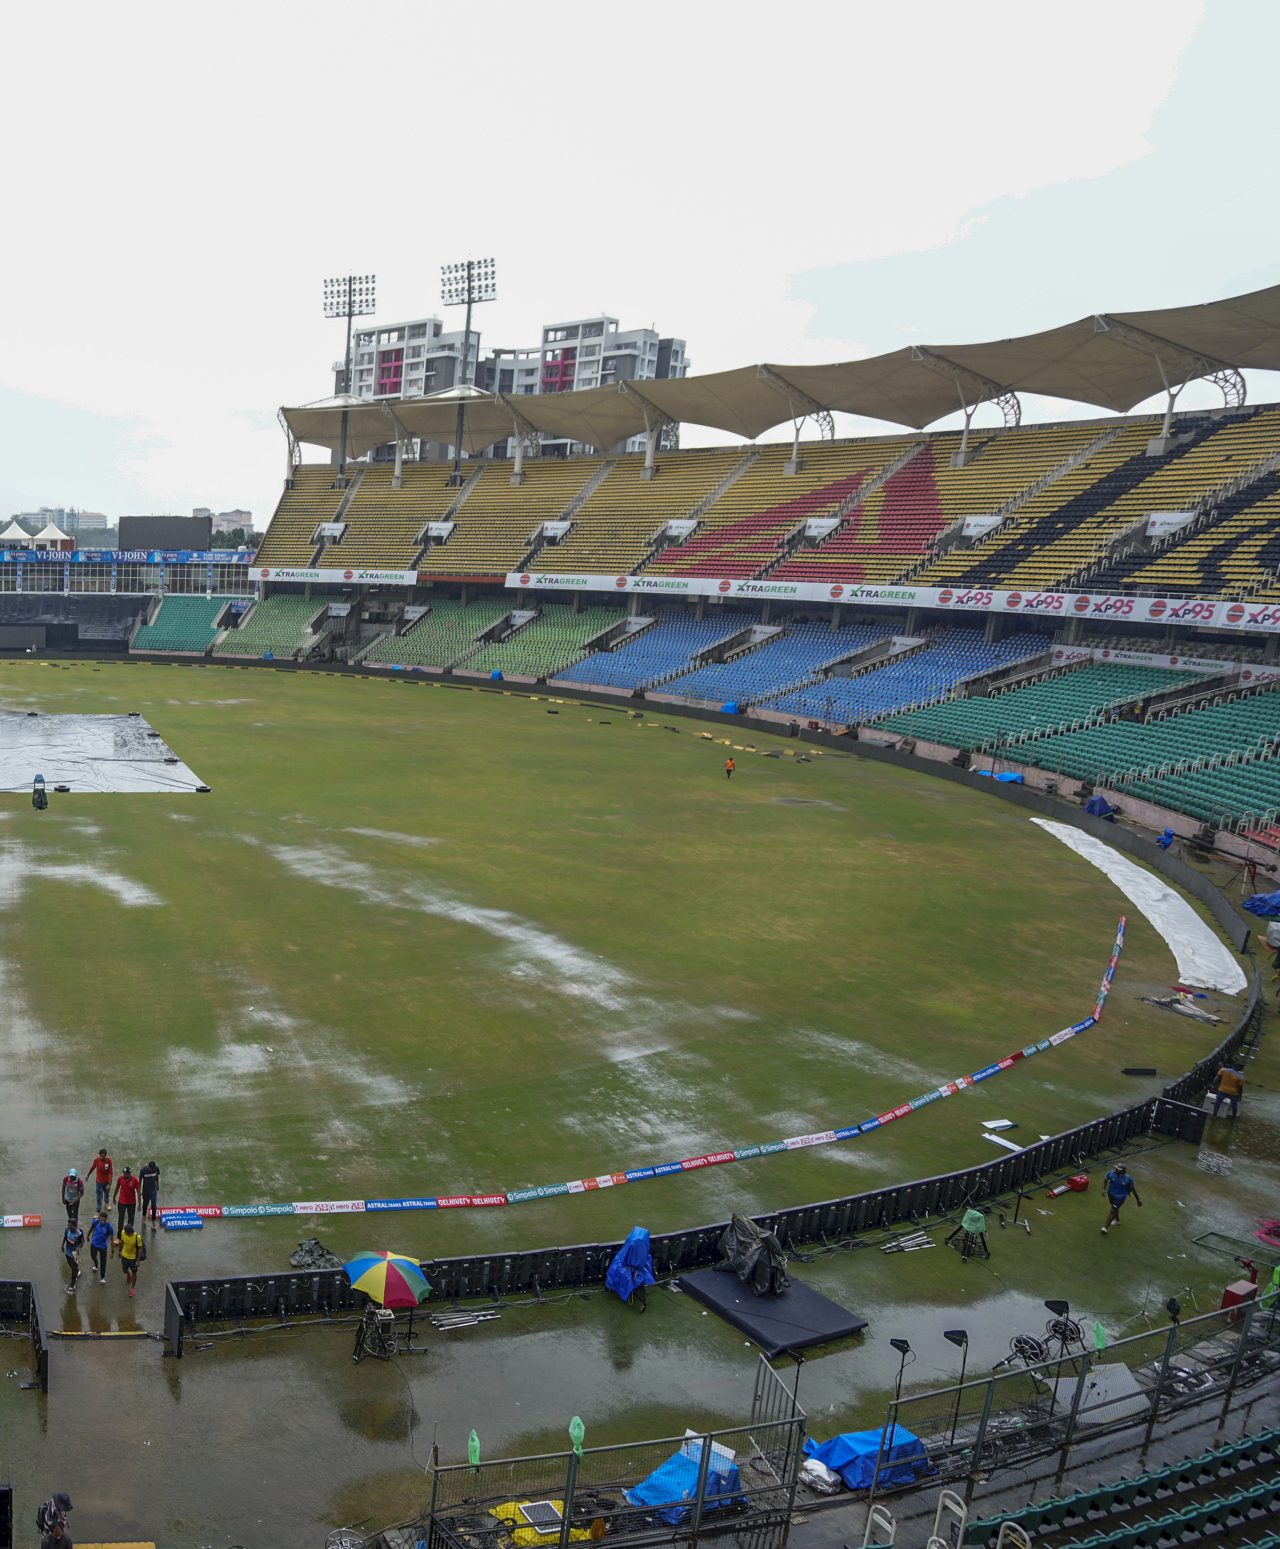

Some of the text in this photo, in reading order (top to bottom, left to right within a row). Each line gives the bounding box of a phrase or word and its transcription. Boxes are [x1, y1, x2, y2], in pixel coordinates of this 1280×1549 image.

[36, 551, 72, 560] VI-JOHN
[111, 551, 148, 560] VI-JOHN
[275, 569, 319, 578] XTRAGREEN
[358, 570, 405, 580] XTRAGREEN
[535, 575, 588, 585] XTRAGREEN
[633, 577, 689, 588] XTRAGREEN
[737, 582, 798, 594] XTRAGREEN
[850, 586, 916, 600] XTRAGREEN
[954, 590, 993, 606] XP95
[1023, 593, 1065, 610] XP95
[1091, 597, 1135, 615] XP95
[1167, 601, 1216, 620] XP95
[1114, 652, 1153, 661] XTRAGREEN
[1182, 659, 1224, 669] XTRAGREEN
[739, 1147, 760, 1157] Simpolo
[766, 1142, 785, 1152] Simpolo
[708, 1152, 734, 1162] DELHIVERY
[682, 1158, 707, 1169] DELHIVERY
[655, 1166, 671, 1174] ASTRAL
[515, 1190, 537, 1200] Simpolo
[544, 1185, 568, 1196] Simpolo
[439, 1197, 470, 1206] DELHIVERY
[472, 1196, 505, 1205] DELHIVERY
[230, 1206, 257, 1215] Simpolo
[266, 1205, 293, 1214] Simpolo
[167, 1219, 188, 1227] ASTRAL
